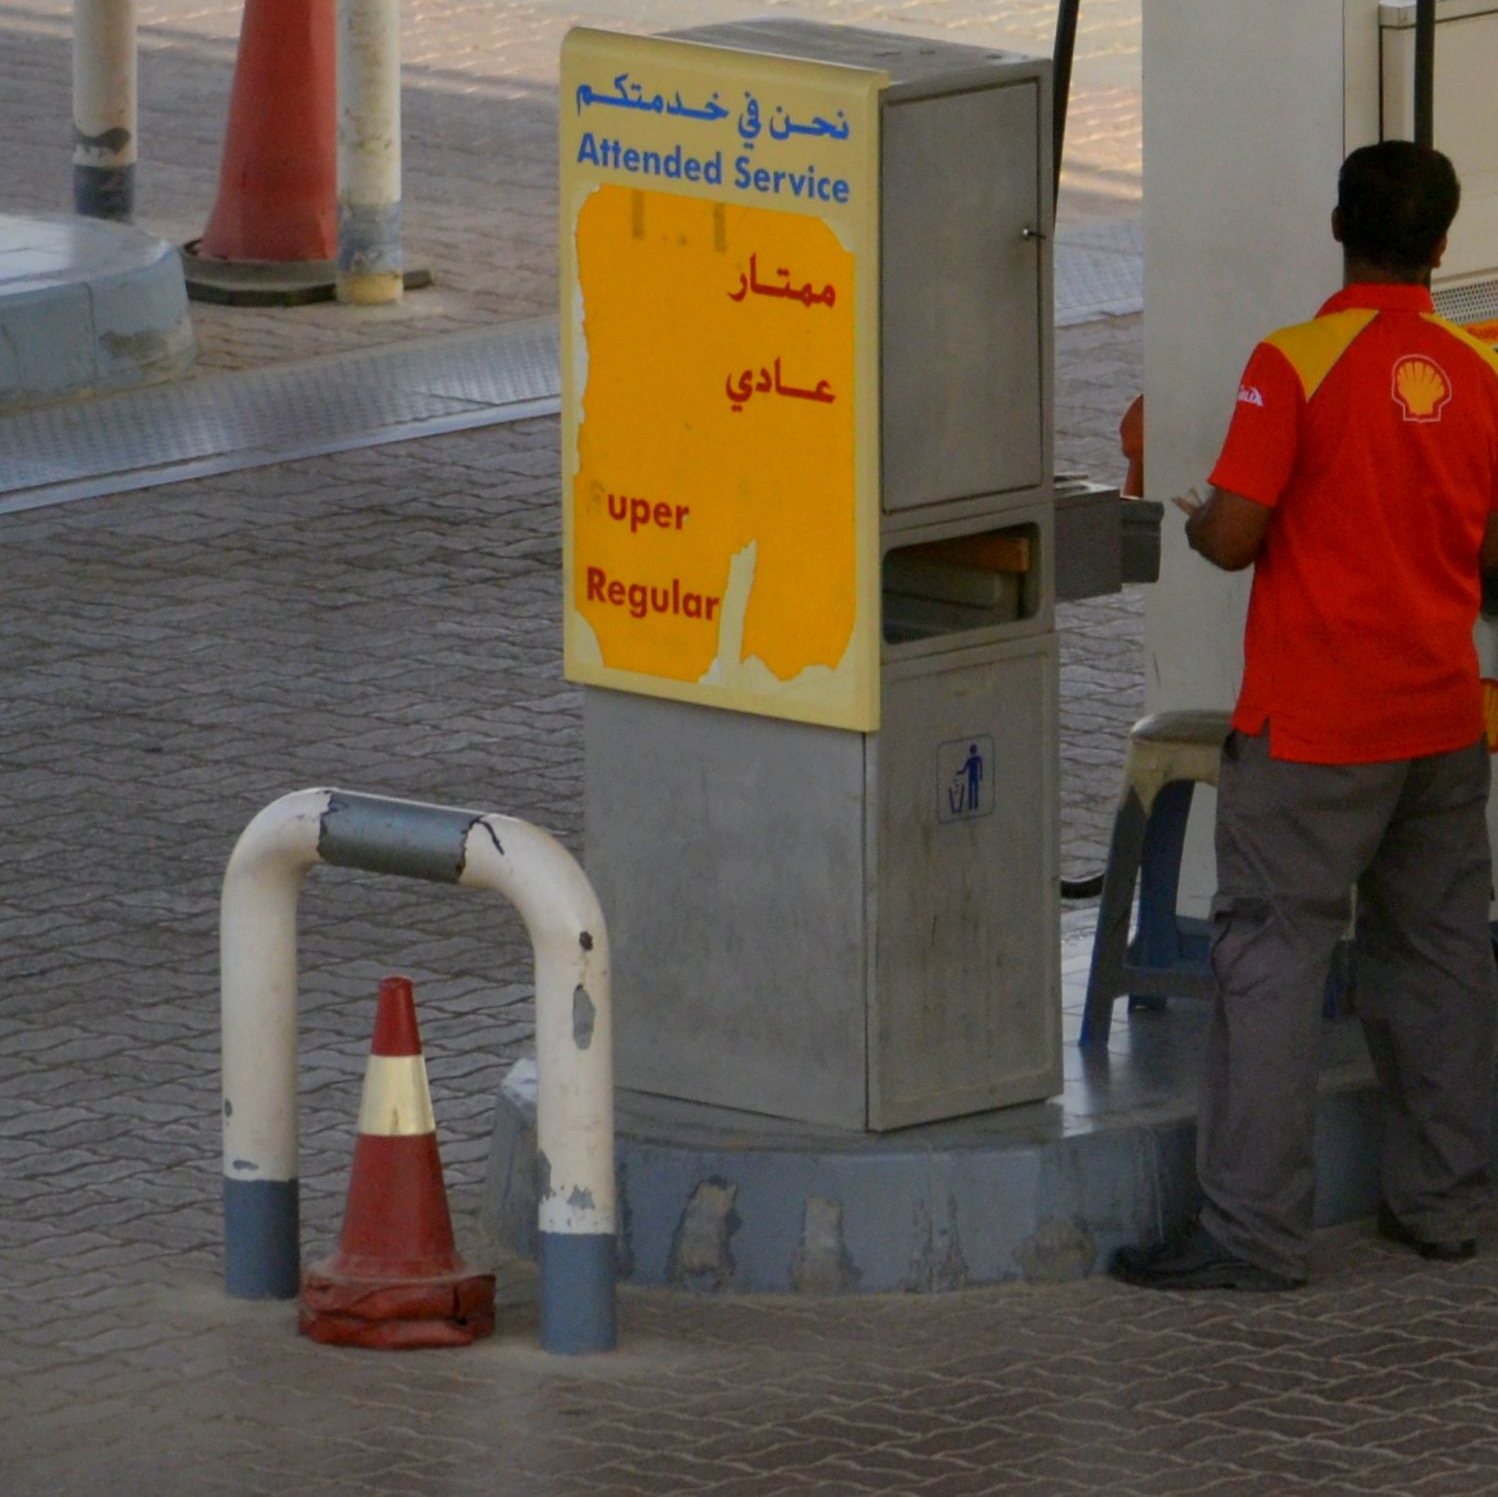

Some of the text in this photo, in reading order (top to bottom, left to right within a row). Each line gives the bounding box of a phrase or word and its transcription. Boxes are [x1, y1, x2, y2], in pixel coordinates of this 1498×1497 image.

[576, 73, 850, 150] نحن في خدمتكم
[576, 132, 850, 204] Attended Service
[726, 356, 837, 413] عادي
[592, 489, 690, 533] uper
[586, 566, 720, 621] Regular
